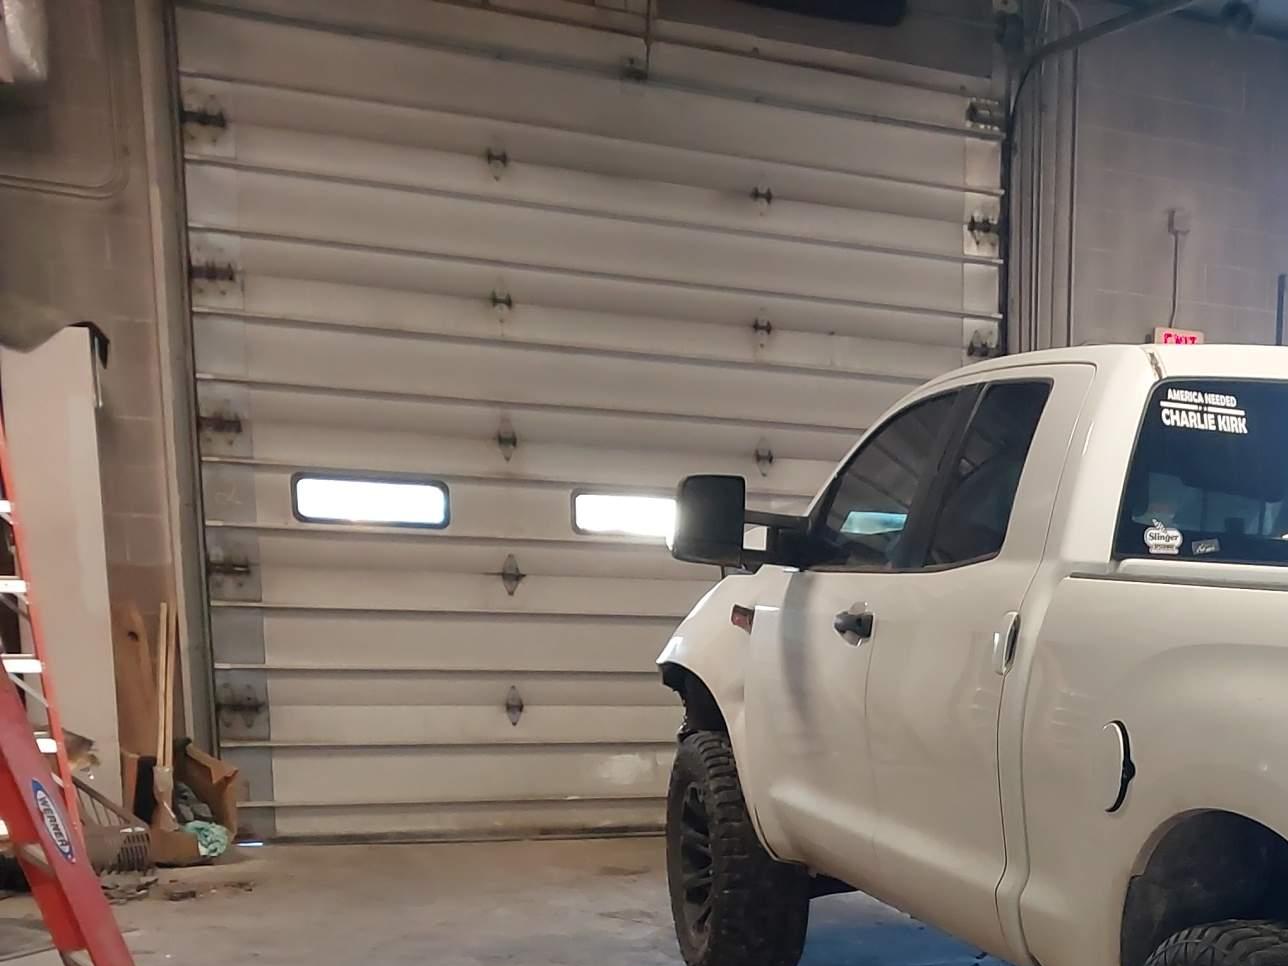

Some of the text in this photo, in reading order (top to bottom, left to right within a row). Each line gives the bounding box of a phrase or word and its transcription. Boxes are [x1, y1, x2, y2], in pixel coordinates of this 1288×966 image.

[1167, 388, 1237, 408] AMERICA NEEDED
[1161, 408, 1248, 434] CHARLIE KIRK
[1149, 532, 1179, 543] Slinger
[39, 797, 69, 848] WERNER
